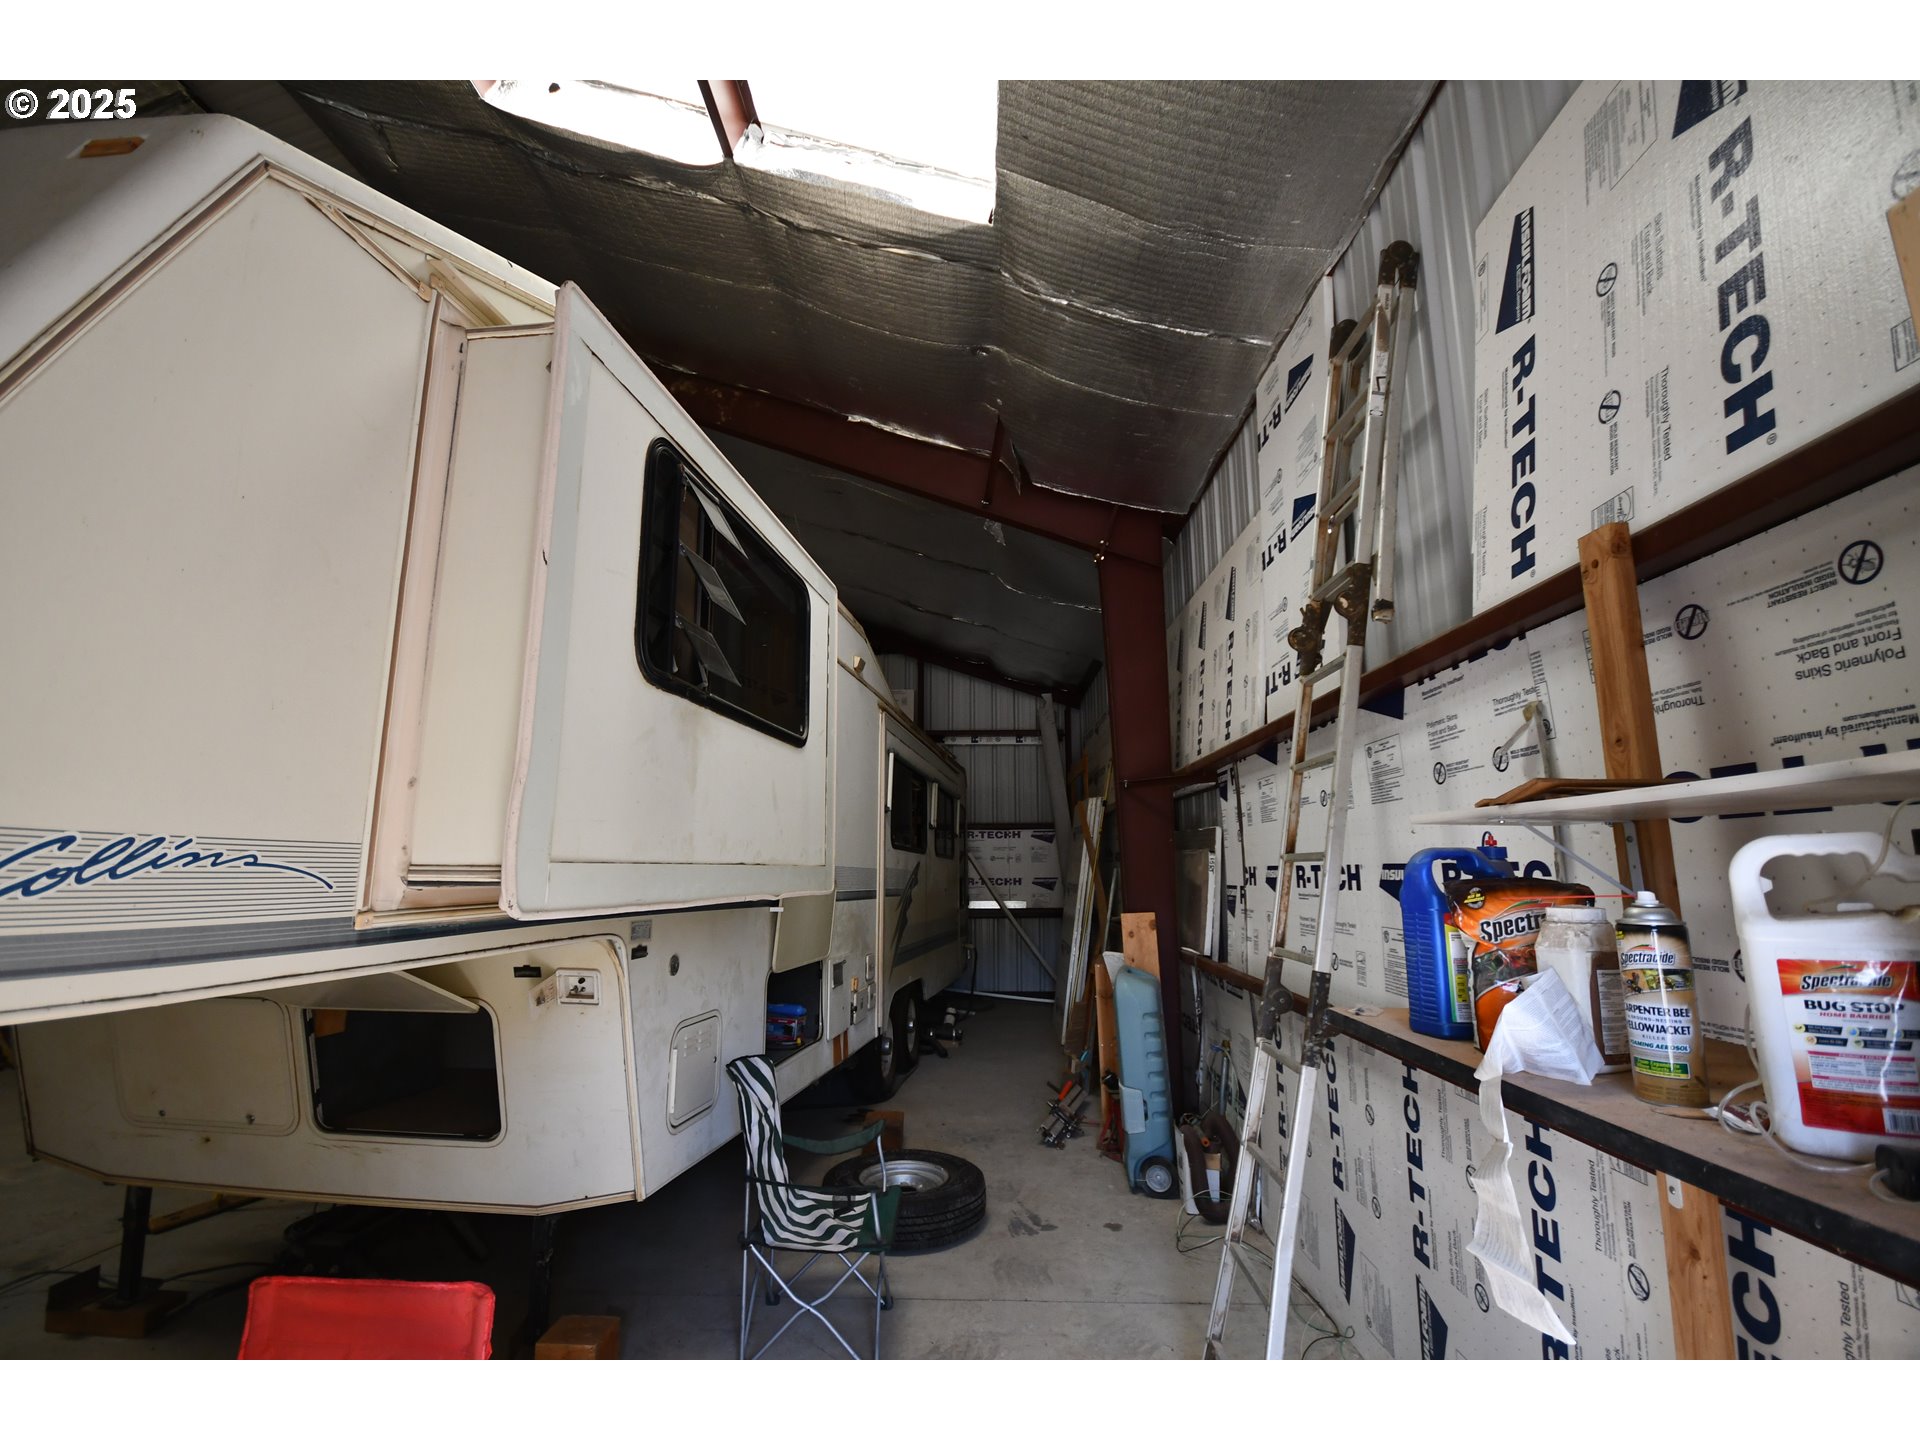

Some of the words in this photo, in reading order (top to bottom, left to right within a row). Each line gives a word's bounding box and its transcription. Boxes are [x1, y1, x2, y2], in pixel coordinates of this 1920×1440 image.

[1660, 366, 1669, 424] Thoroughly
[1663, 425, 1672, 461] Tested
[1480, 506, 1488, 548] Thoroughly
[1813, 571, 1836, 582] RIGID
[1768, 579, 1812, 599] INSULATION
[1809, 579, 1837, 594] INSECT
[1767, 590, 1807, 608] RESISTANT
[1862, 627, 1902, 646] Front
[1796, 646, 1830, 663] Back
[1833, 638, 1859, 656] and
[1835, 645, 1906, 672] Polymeric
[1795, 664, 1832, 680] Skins
[1225, 630, 1234, 741] R-TECH
[1492, 692, 1521, 705] Thoroughly
[1522, 687, 1537, 696] Teste
[1428, 728, 1438, 738] Front
[1439, 726, 1447, 734] and
[1447, 724, 1458, 732] Back
[1825, 725, 1838, 737] by
[1841, 713, 1919, 735] Manufactured
[0, 835, 333, 897] Collins
[1626, 1003, 1670, 1017] ARPENTER
[1673, 1008, 1690, 1017] BEE
[1804, 1000, 1846, 1012] BUG
[1851, 1002, 1904, 1014] STOP
[1628, 1020, 1691, 1035] ELLOWJACKET
[1588, 1159, 1596, 1192] Tested
[1592, 1195, 1602, 1252] Thoroughly
[1838, 1281, 1851, 1328] Tested
[1573, 1328, 1578, 1338] by
